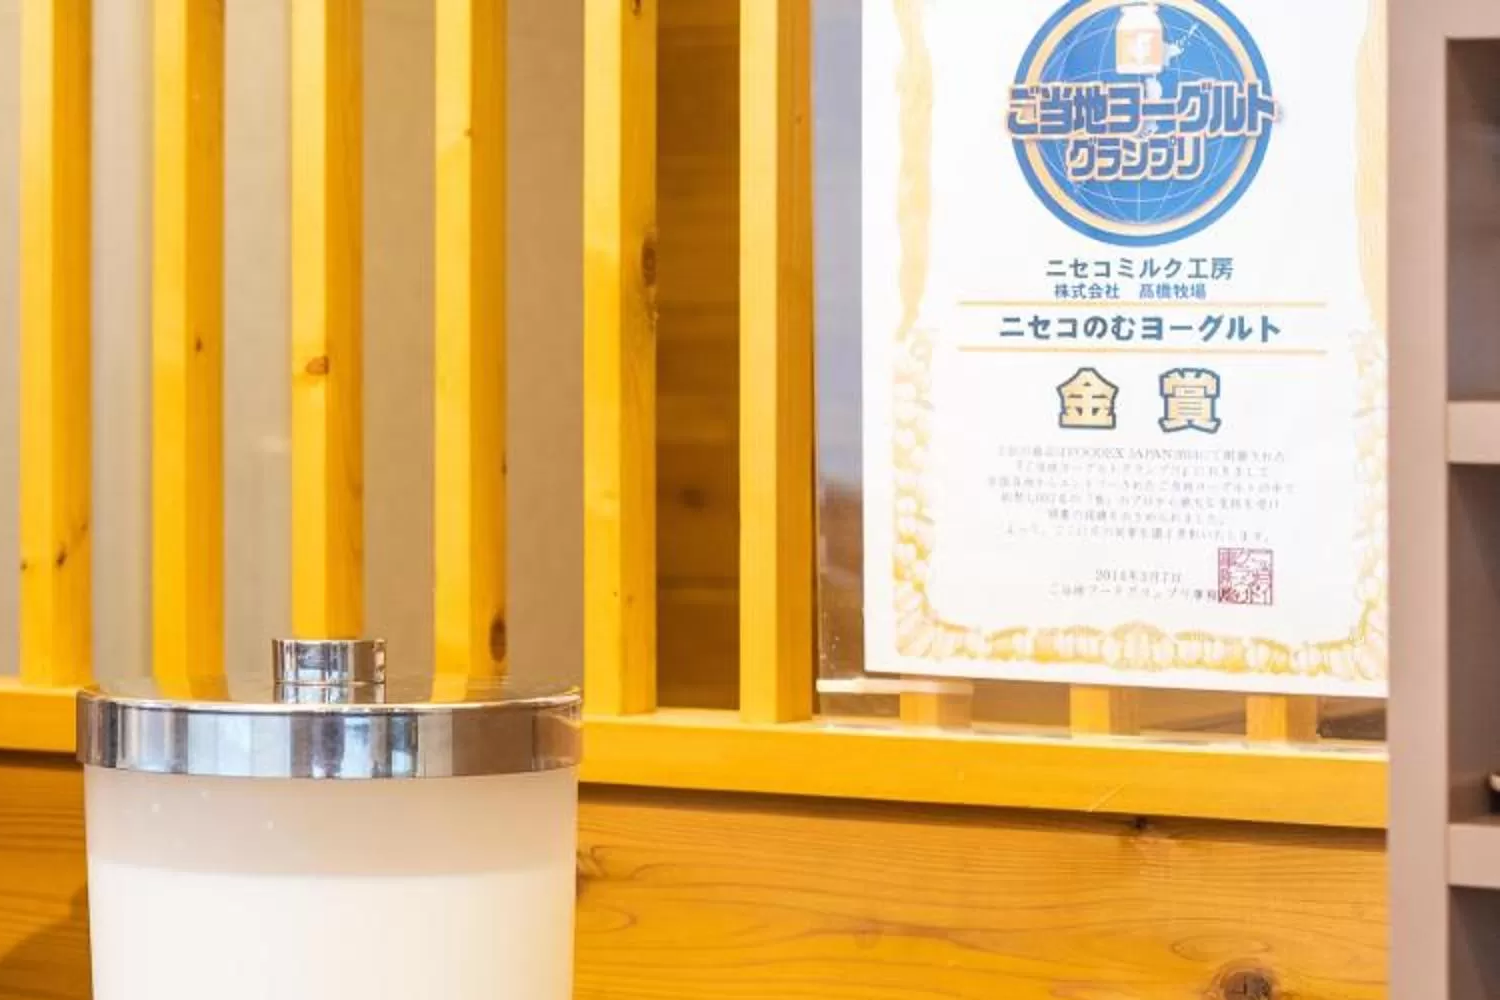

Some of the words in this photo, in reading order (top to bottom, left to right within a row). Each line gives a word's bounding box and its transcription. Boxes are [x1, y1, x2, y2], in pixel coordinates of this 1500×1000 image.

[1005, 79, 1277, 137] ご当地ヨーグルト
[1068, 134, 1205, 180] グランプリ
[1045, 256, 1235, 281] ニセコミルク工房
[1053, 283, 1121, 300] 株式会社
[999, 313, 1283, 343] ニセコのむヨーグルト
